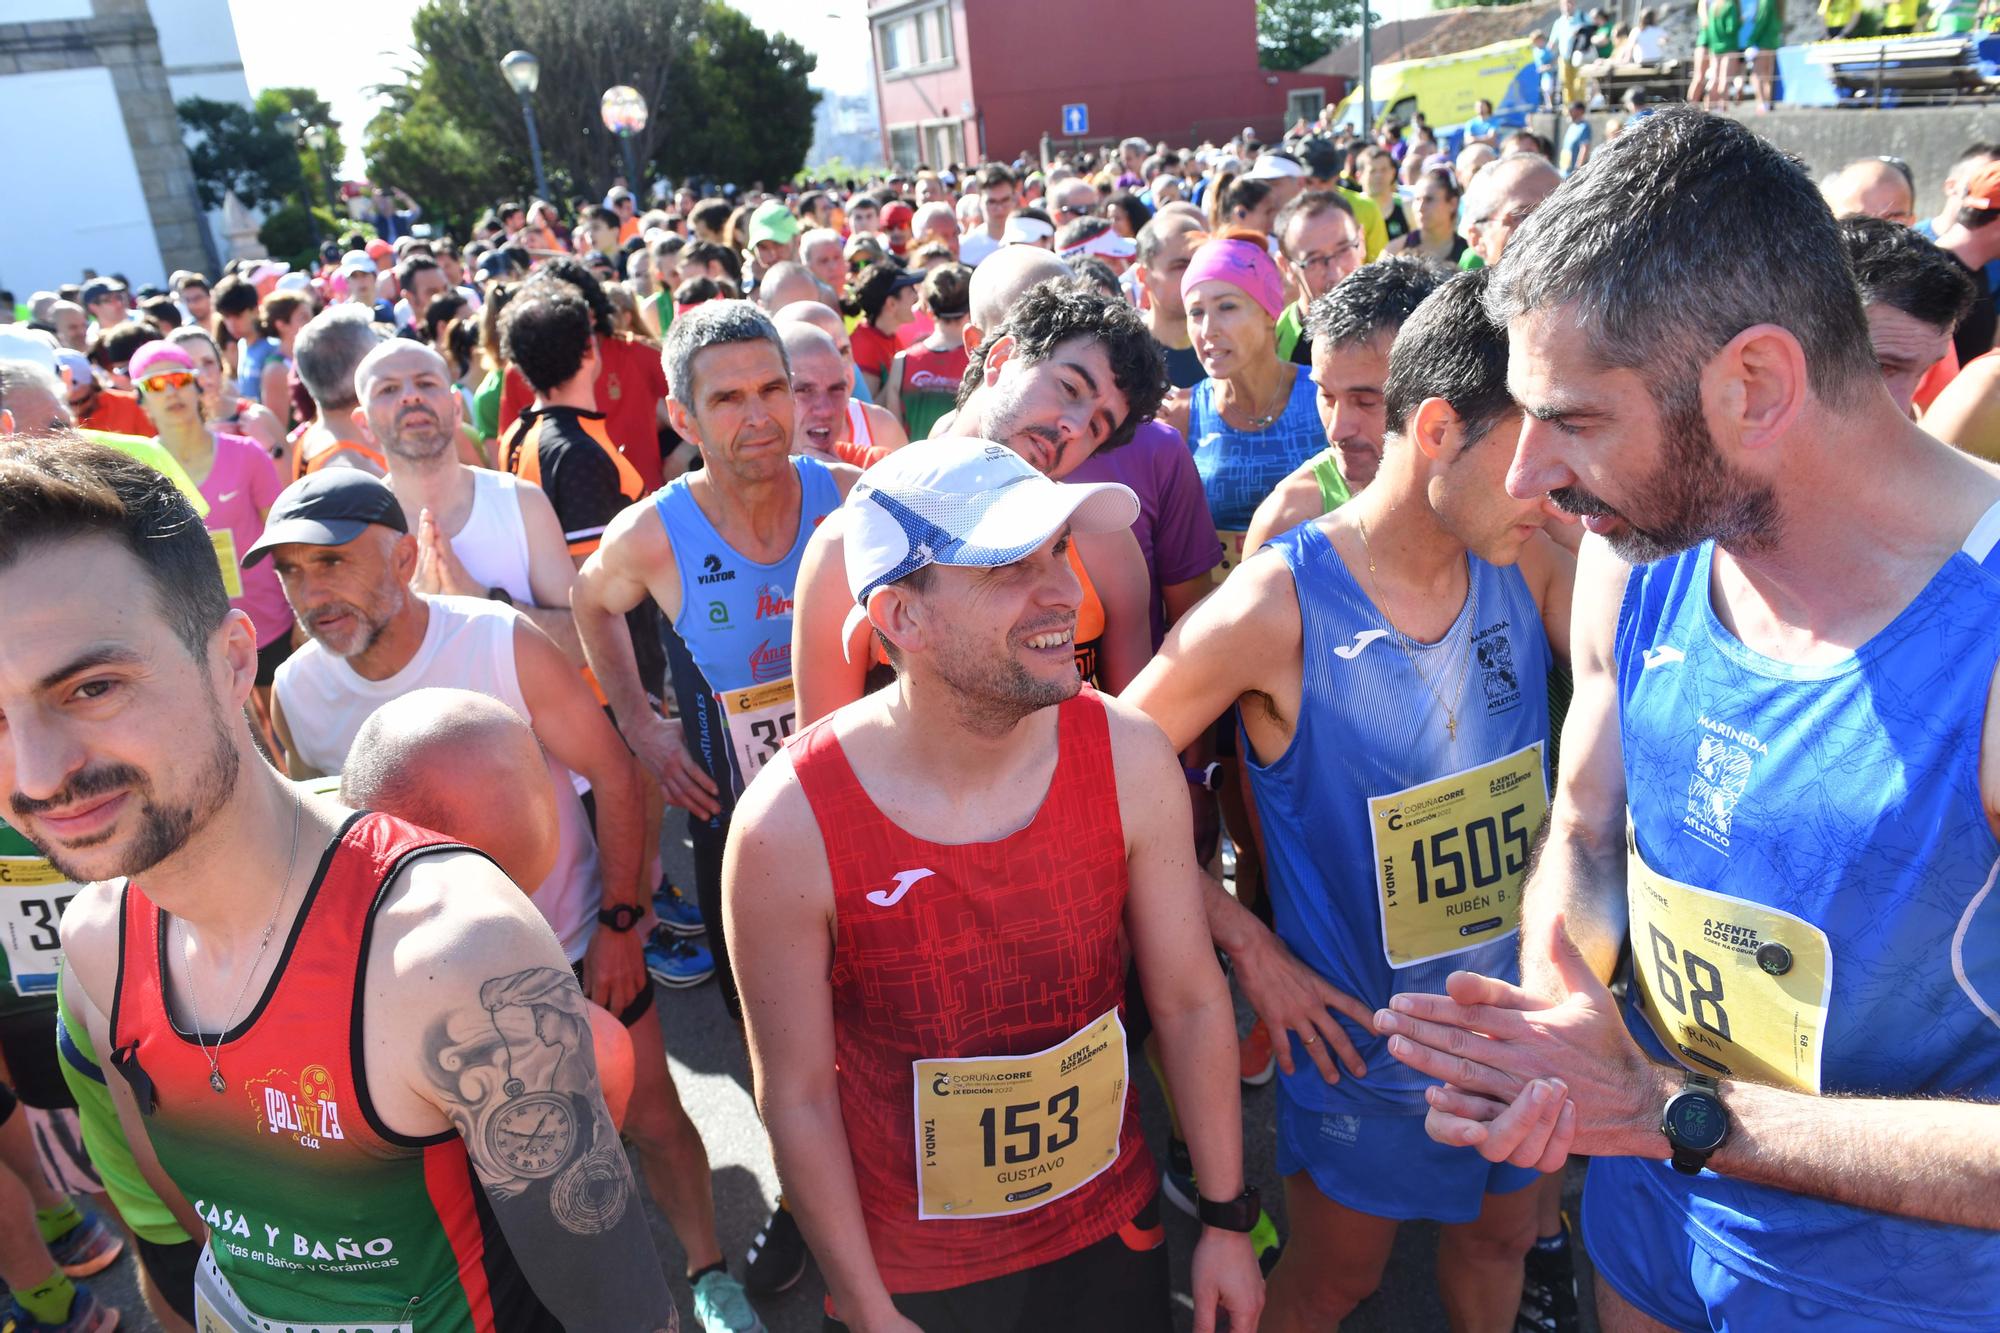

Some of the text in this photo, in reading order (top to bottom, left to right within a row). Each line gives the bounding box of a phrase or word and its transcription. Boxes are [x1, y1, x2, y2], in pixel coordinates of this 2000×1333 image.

[697, 570, 736, 585] VIATOR
[1697, 714, 1769, 757] MARINEDA
[1683, 815, 1730, 847] ATLETICO
[1411, 803, 1529, 904] 1505
[1383, 855, 1396, 898] TANDA
[1445, 896, 1490, 917] RUBÉN
[1704, 918, 1758, 939] A XENTE
[1704, 927, 1729, 942] DOS
[1648, 921, 1733, 1043] 68
[1678, 1020, 1722, 1052] FRAN
[1800, 1034, 1809, 1048] 68
[1060, 1044, 1090, 1067] A XENTE
[1060, 1060, 1077, 1073] DOS
[1077, 1041, 1108, 1064] BARRIOS
[953, 1071, 1032, 1083] CORUÑACORRE
[953, 1087, 961, 1095] IX
[962, 1087, 993, 1095] EDICIÓN
[924, 1118, 936, 1157] TANDA
[979, 1085, 1080, 1168] 153
[300, 1133, 320, 1150] cia
[997, 1156, 1065, 1184] GUSTAVO
[194, 1199, 393, 1262] CASA Y BAÑO
[251, 1247, 265, 1262] en
[266, 1252, 303, 1270] Baños
[306, 1263, 316, 1272] y
[318, 1257, 400, 1273] Cerámicas
